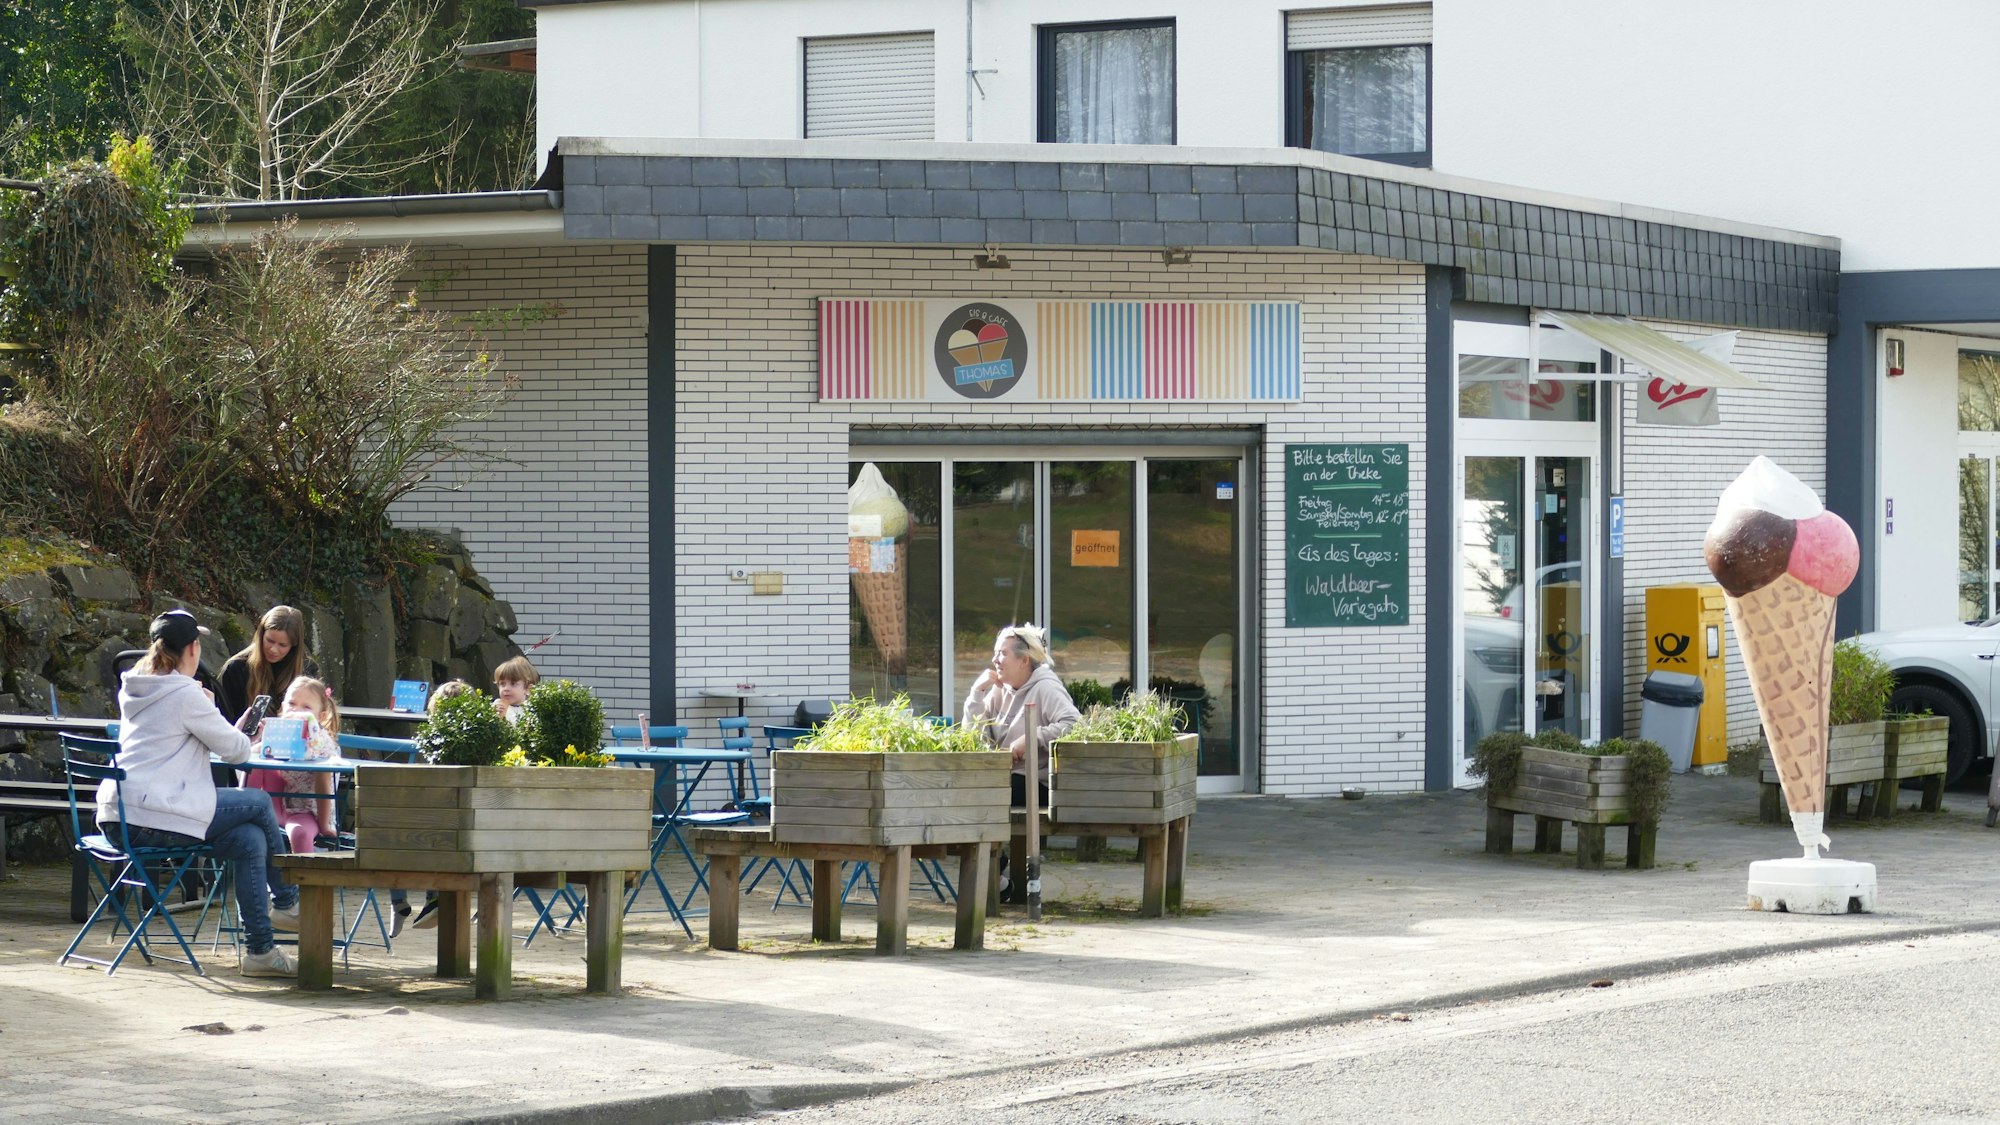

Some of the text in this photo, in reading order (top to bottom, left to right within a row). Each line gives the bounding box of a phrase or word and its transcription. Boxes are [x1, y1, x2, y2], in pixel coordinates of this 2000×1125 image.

[959, 364, 1007, 379] THOMAS
[1293, 447, 1403, 466] Bitte bestellen Sie
[1303, 465, 1382, 481] an der Theke
[1298, 495, 1333, 512] Freitag
[1887, 501, 1891, 516] P
[1613, 503, 1621, 529] P
[1316, 519, 1360, 531] Feiertag
[1075, 543, 1116, 554] geöffnet
[1298, 543, 1399, 567] Eis des Tages:
[1332, 594, 1399, 620] Variegato
